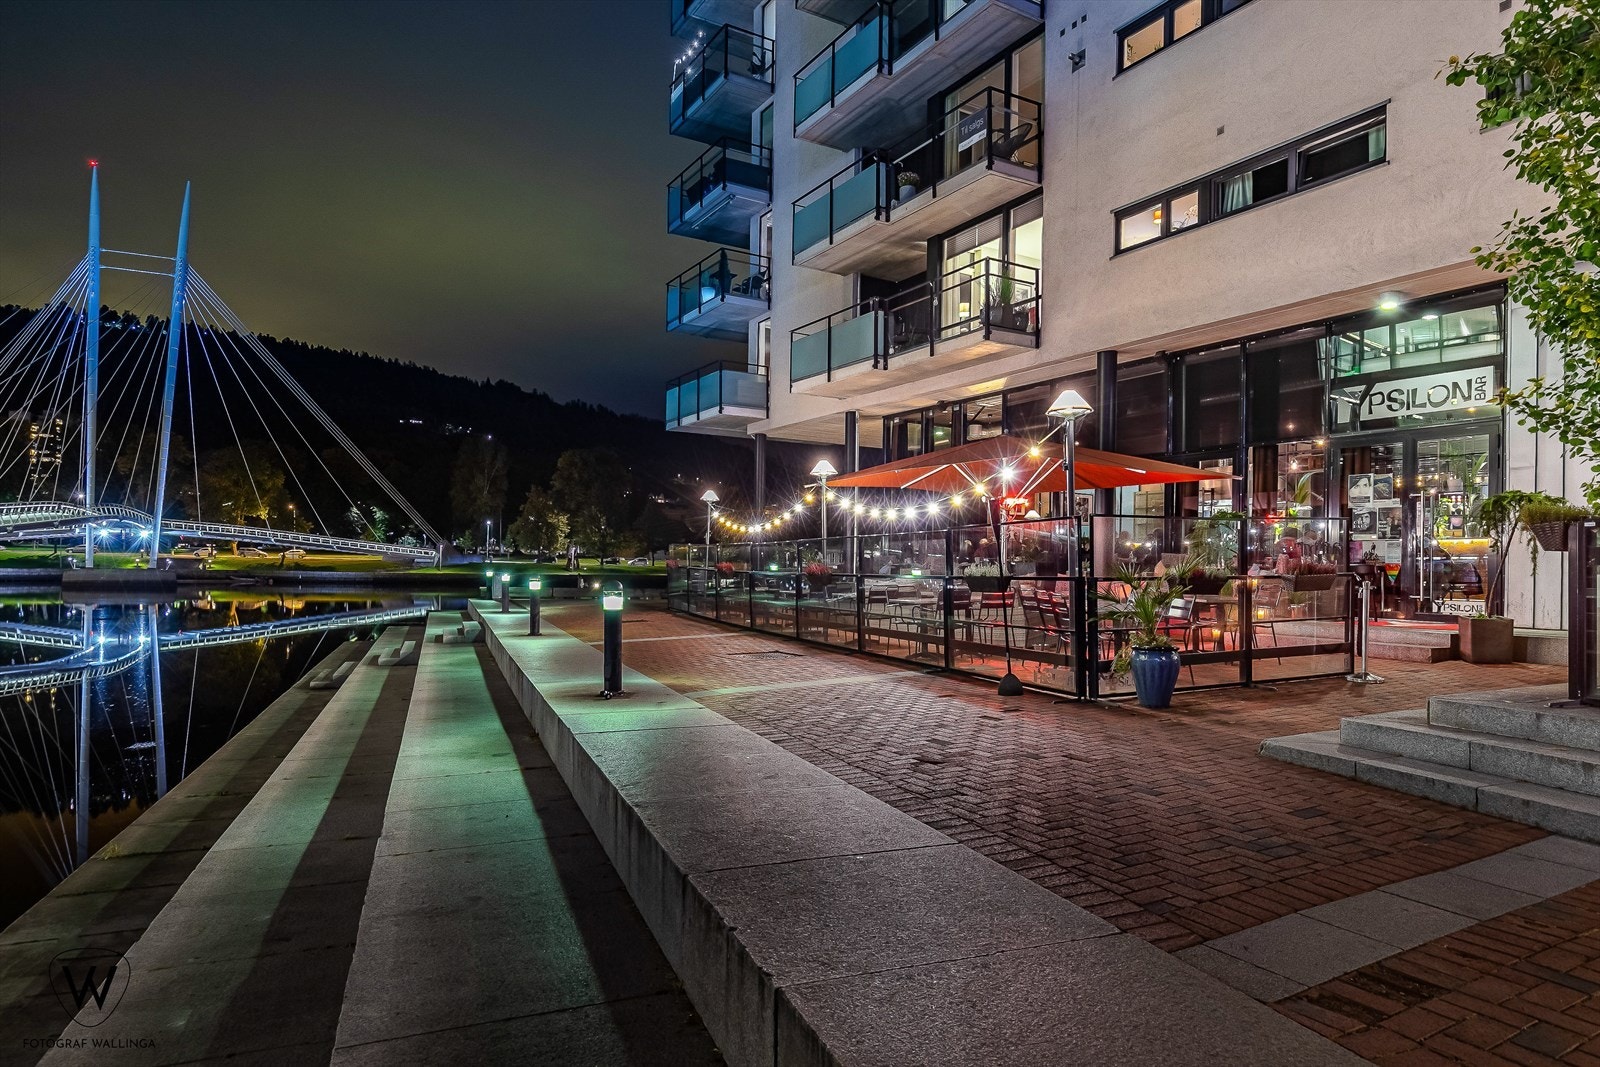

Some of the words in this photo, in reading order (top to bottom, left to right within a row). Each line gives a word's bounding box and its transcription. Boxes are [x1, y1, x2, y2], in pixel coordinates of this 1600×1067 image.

[969, 118, 984, 132] salgs
[1474, 375, 1486, 400] BAR
[1331, 379, 1472, 426] YPSILON
[1432, 600, 1479, 613] YPSILON
